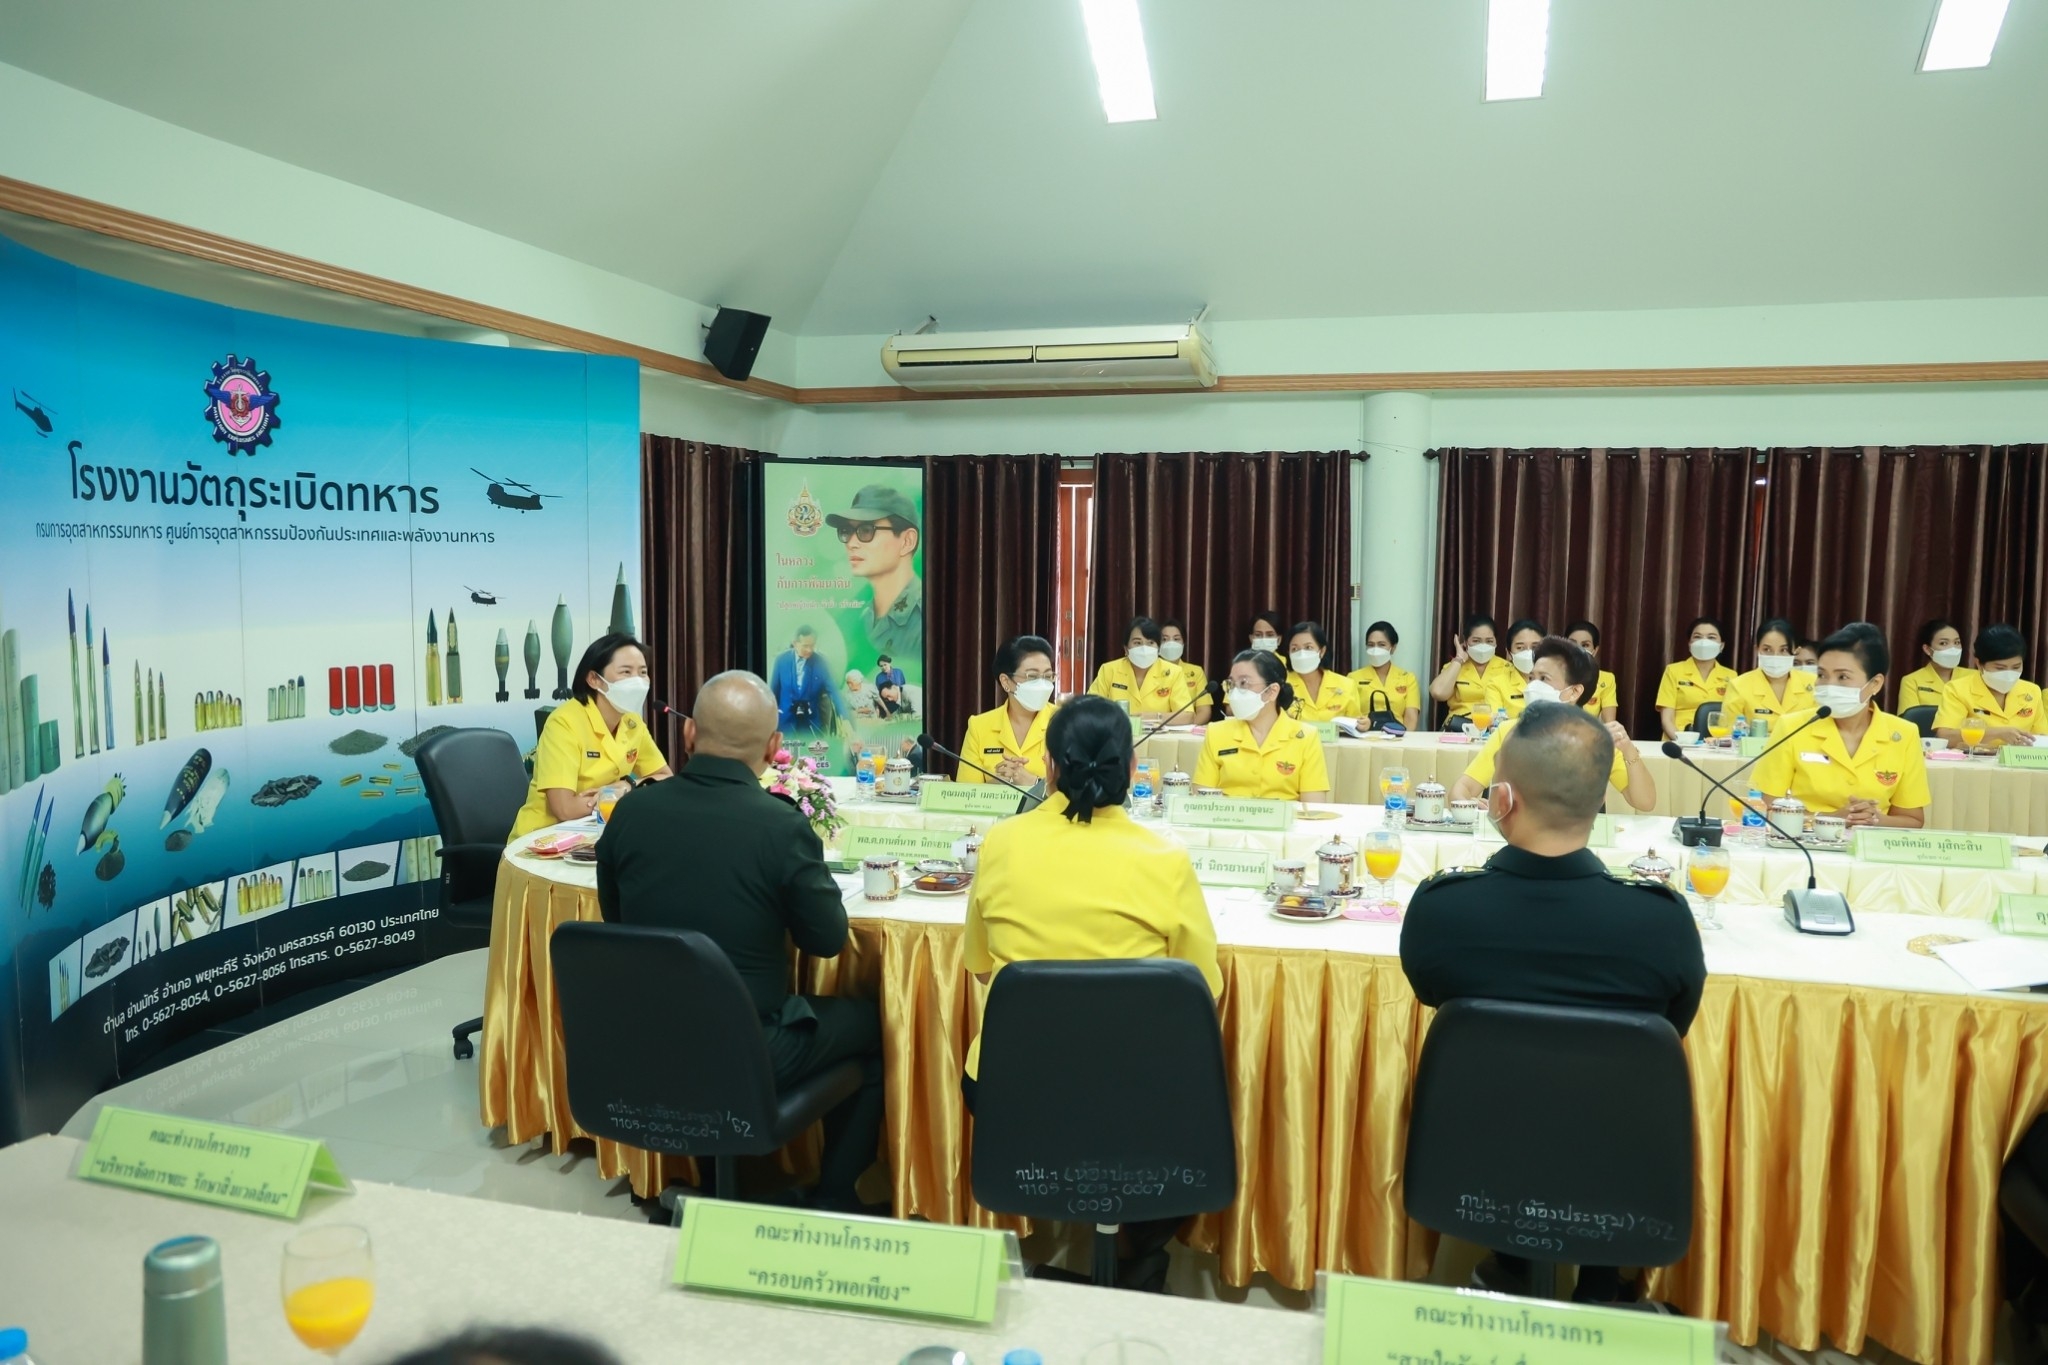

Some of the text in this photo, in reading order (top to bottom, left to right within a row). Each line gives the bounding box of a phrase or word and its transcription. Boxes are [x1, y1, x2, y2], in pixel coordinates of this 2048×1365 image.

[67, 440, 440, 522] โรงงานวัตถุระเบิดทหาร
[35, 522, 495, 545] กรมการอุตสาหกรรมทหาร ศูนย์การอุตสาหกรรมป้องกันประเทศและพลังงานทหาร
[103, 1012, 126, 1034] ตำบล
[162, 977, 192, 999] อำเภอ
[195, 956, 239, 983] พยุหะคีรี
[243, 947, 277, 968] จังหวัด
[279, 926, 335, 954] นครสวรรค์
[339, 920, 376, 937] 60130
[380, 908, 440, 928] ประเทศไทย
[125, 929, 416, 1043] โทร. 0-5627-8054, 0-5627-8056 โทรสาร. 0-5627-8049
[149, 1128, 251, 1159] คณะทำงานโครงการ
[1067, 1195, 1123, 1214] (009)
[755, 1222, 911, 1255] คณะทำงานโครงการ
[1507, 1234, 1563, 1252] (005)
[1414, 1304, 1604, 1346] คณะทำงานโครงการ
